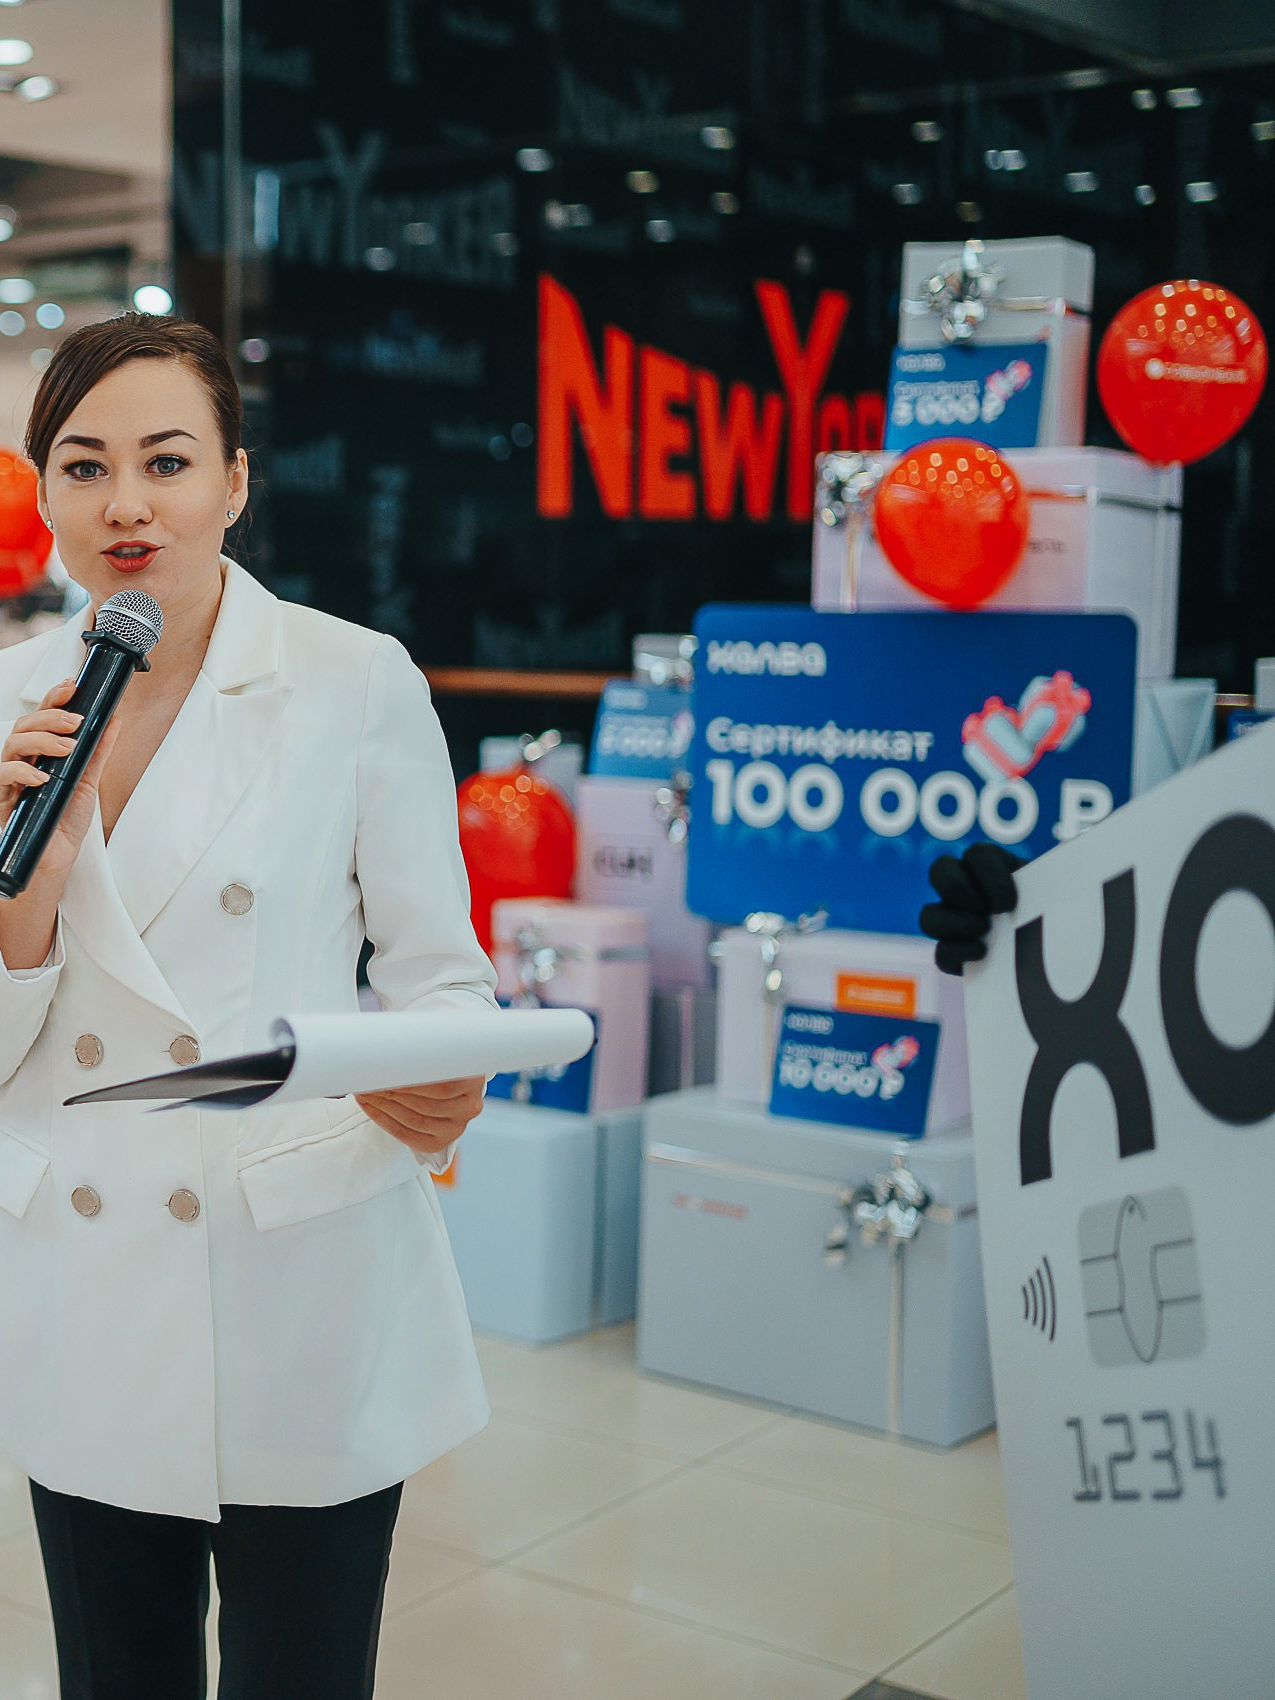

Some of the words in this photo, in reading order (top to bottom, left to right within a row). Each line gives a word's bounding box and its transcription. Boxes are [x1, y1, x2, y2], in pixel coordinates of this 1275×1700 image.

[706, 640, 826, 677] халва
[705, 716, 934, 765] Сертификат
[705, 759, 844, 833] 100
[860, 767, 1039, 845] 000
[779, 1057, 812, 1089] 10
[812, 1060, 880, 1098] 000
[1065, 1408, 1227, 1502] 1234
